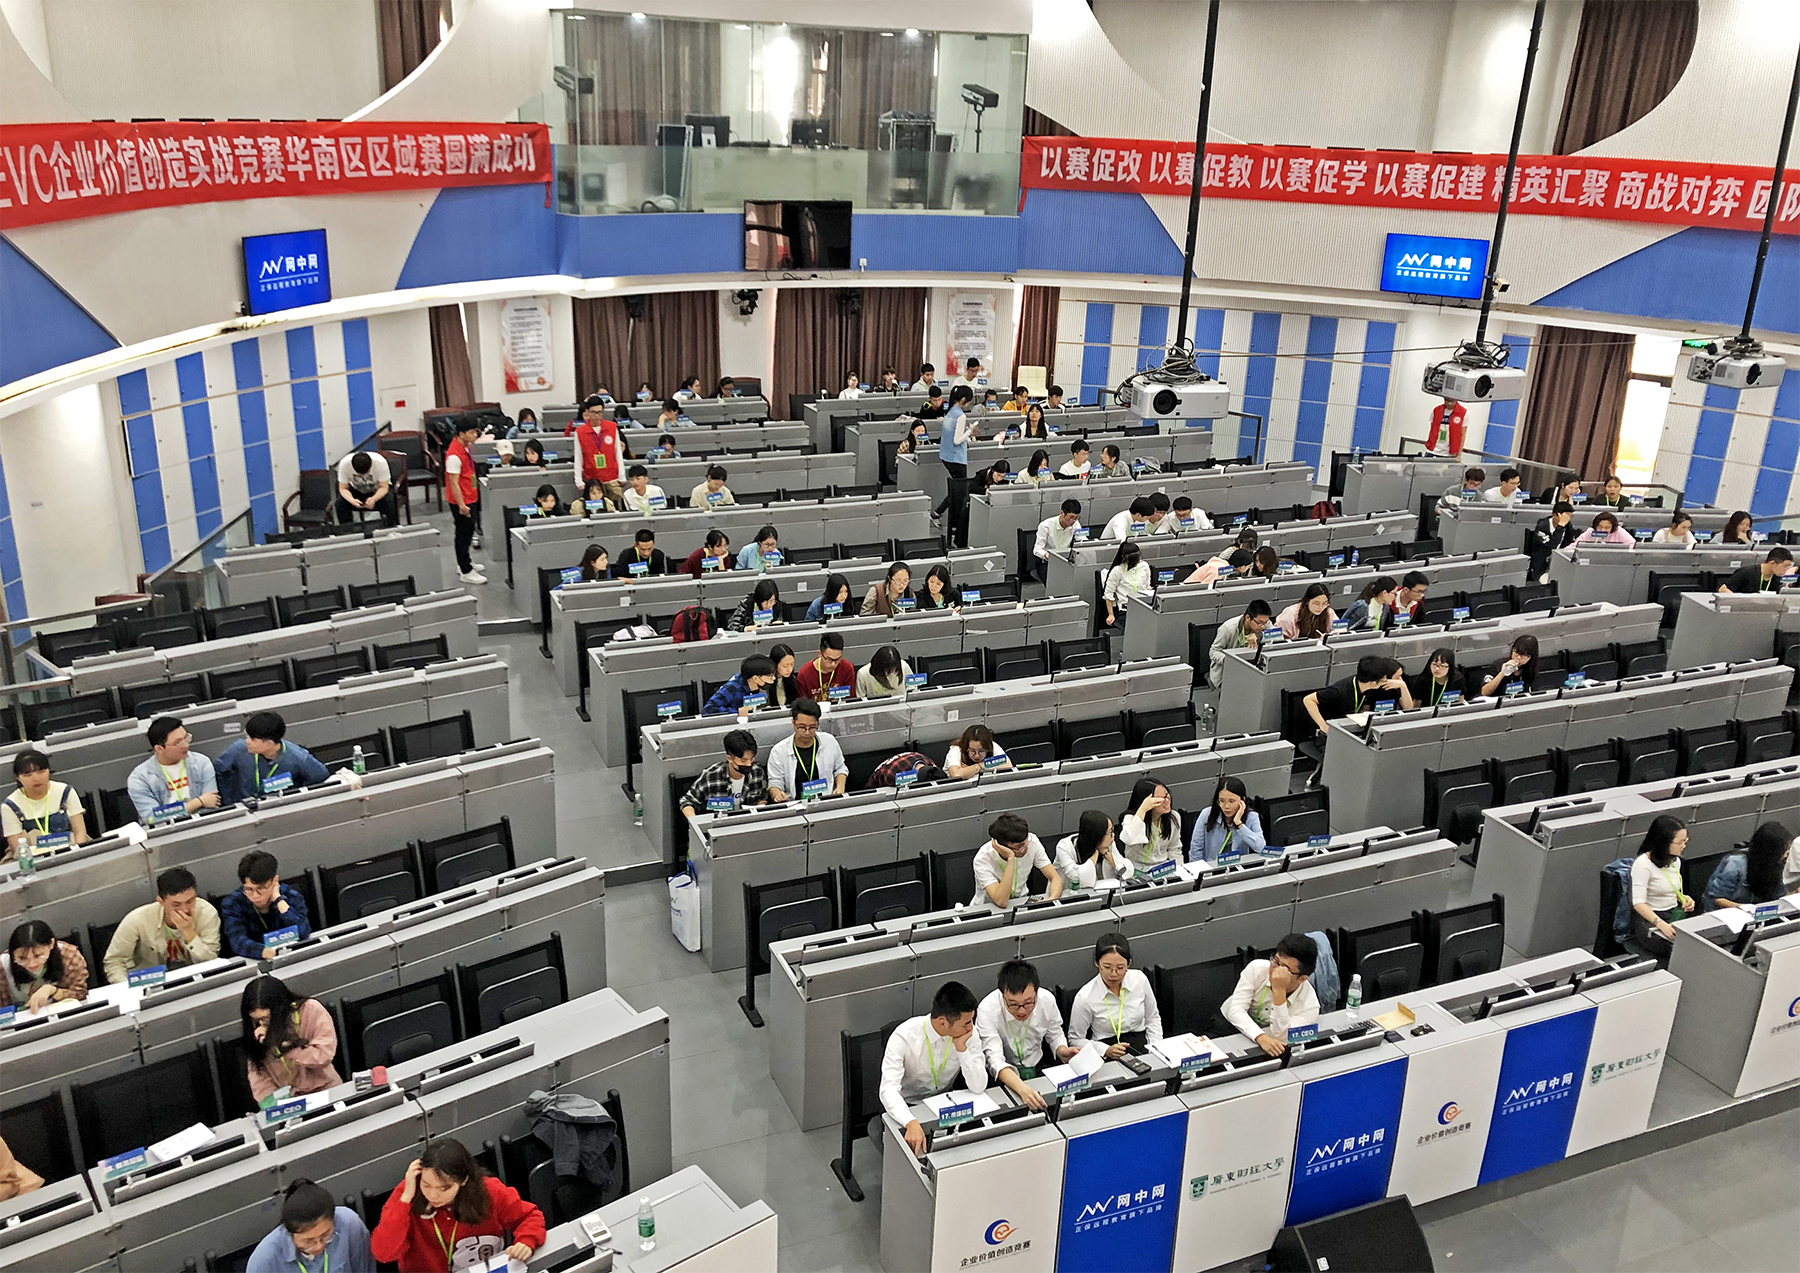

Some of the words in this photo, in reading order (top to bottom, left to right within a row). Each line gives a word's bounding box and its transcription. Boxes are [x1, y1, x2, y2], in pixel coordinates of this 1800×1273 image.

[1040, 146, 1143, 183] 以赛促改
[1149, 151, 1254, 189] 以赛促教
[1259, 156, 1368, 195] 以赛促学
[1374, 162, 1487, 201] 以赛促建
[1491, 165, 1611, 208] 精英汇聚
[1614, 170, 1744, 218] 商战对弈
[285, 253, 318, 273] 网中网
[1430, 254, 1472, 271] 网中网
[1301, 1029, 1314, 1037] CEO
[1535, 1072, 1574, 1094] 网中网
[1342, 1127, 1385, 1153] 网中网
[1116, 1183, 1166, 1210] 网中网
[960, 1240, 1031, 1267] 企业价值创造竞赛
